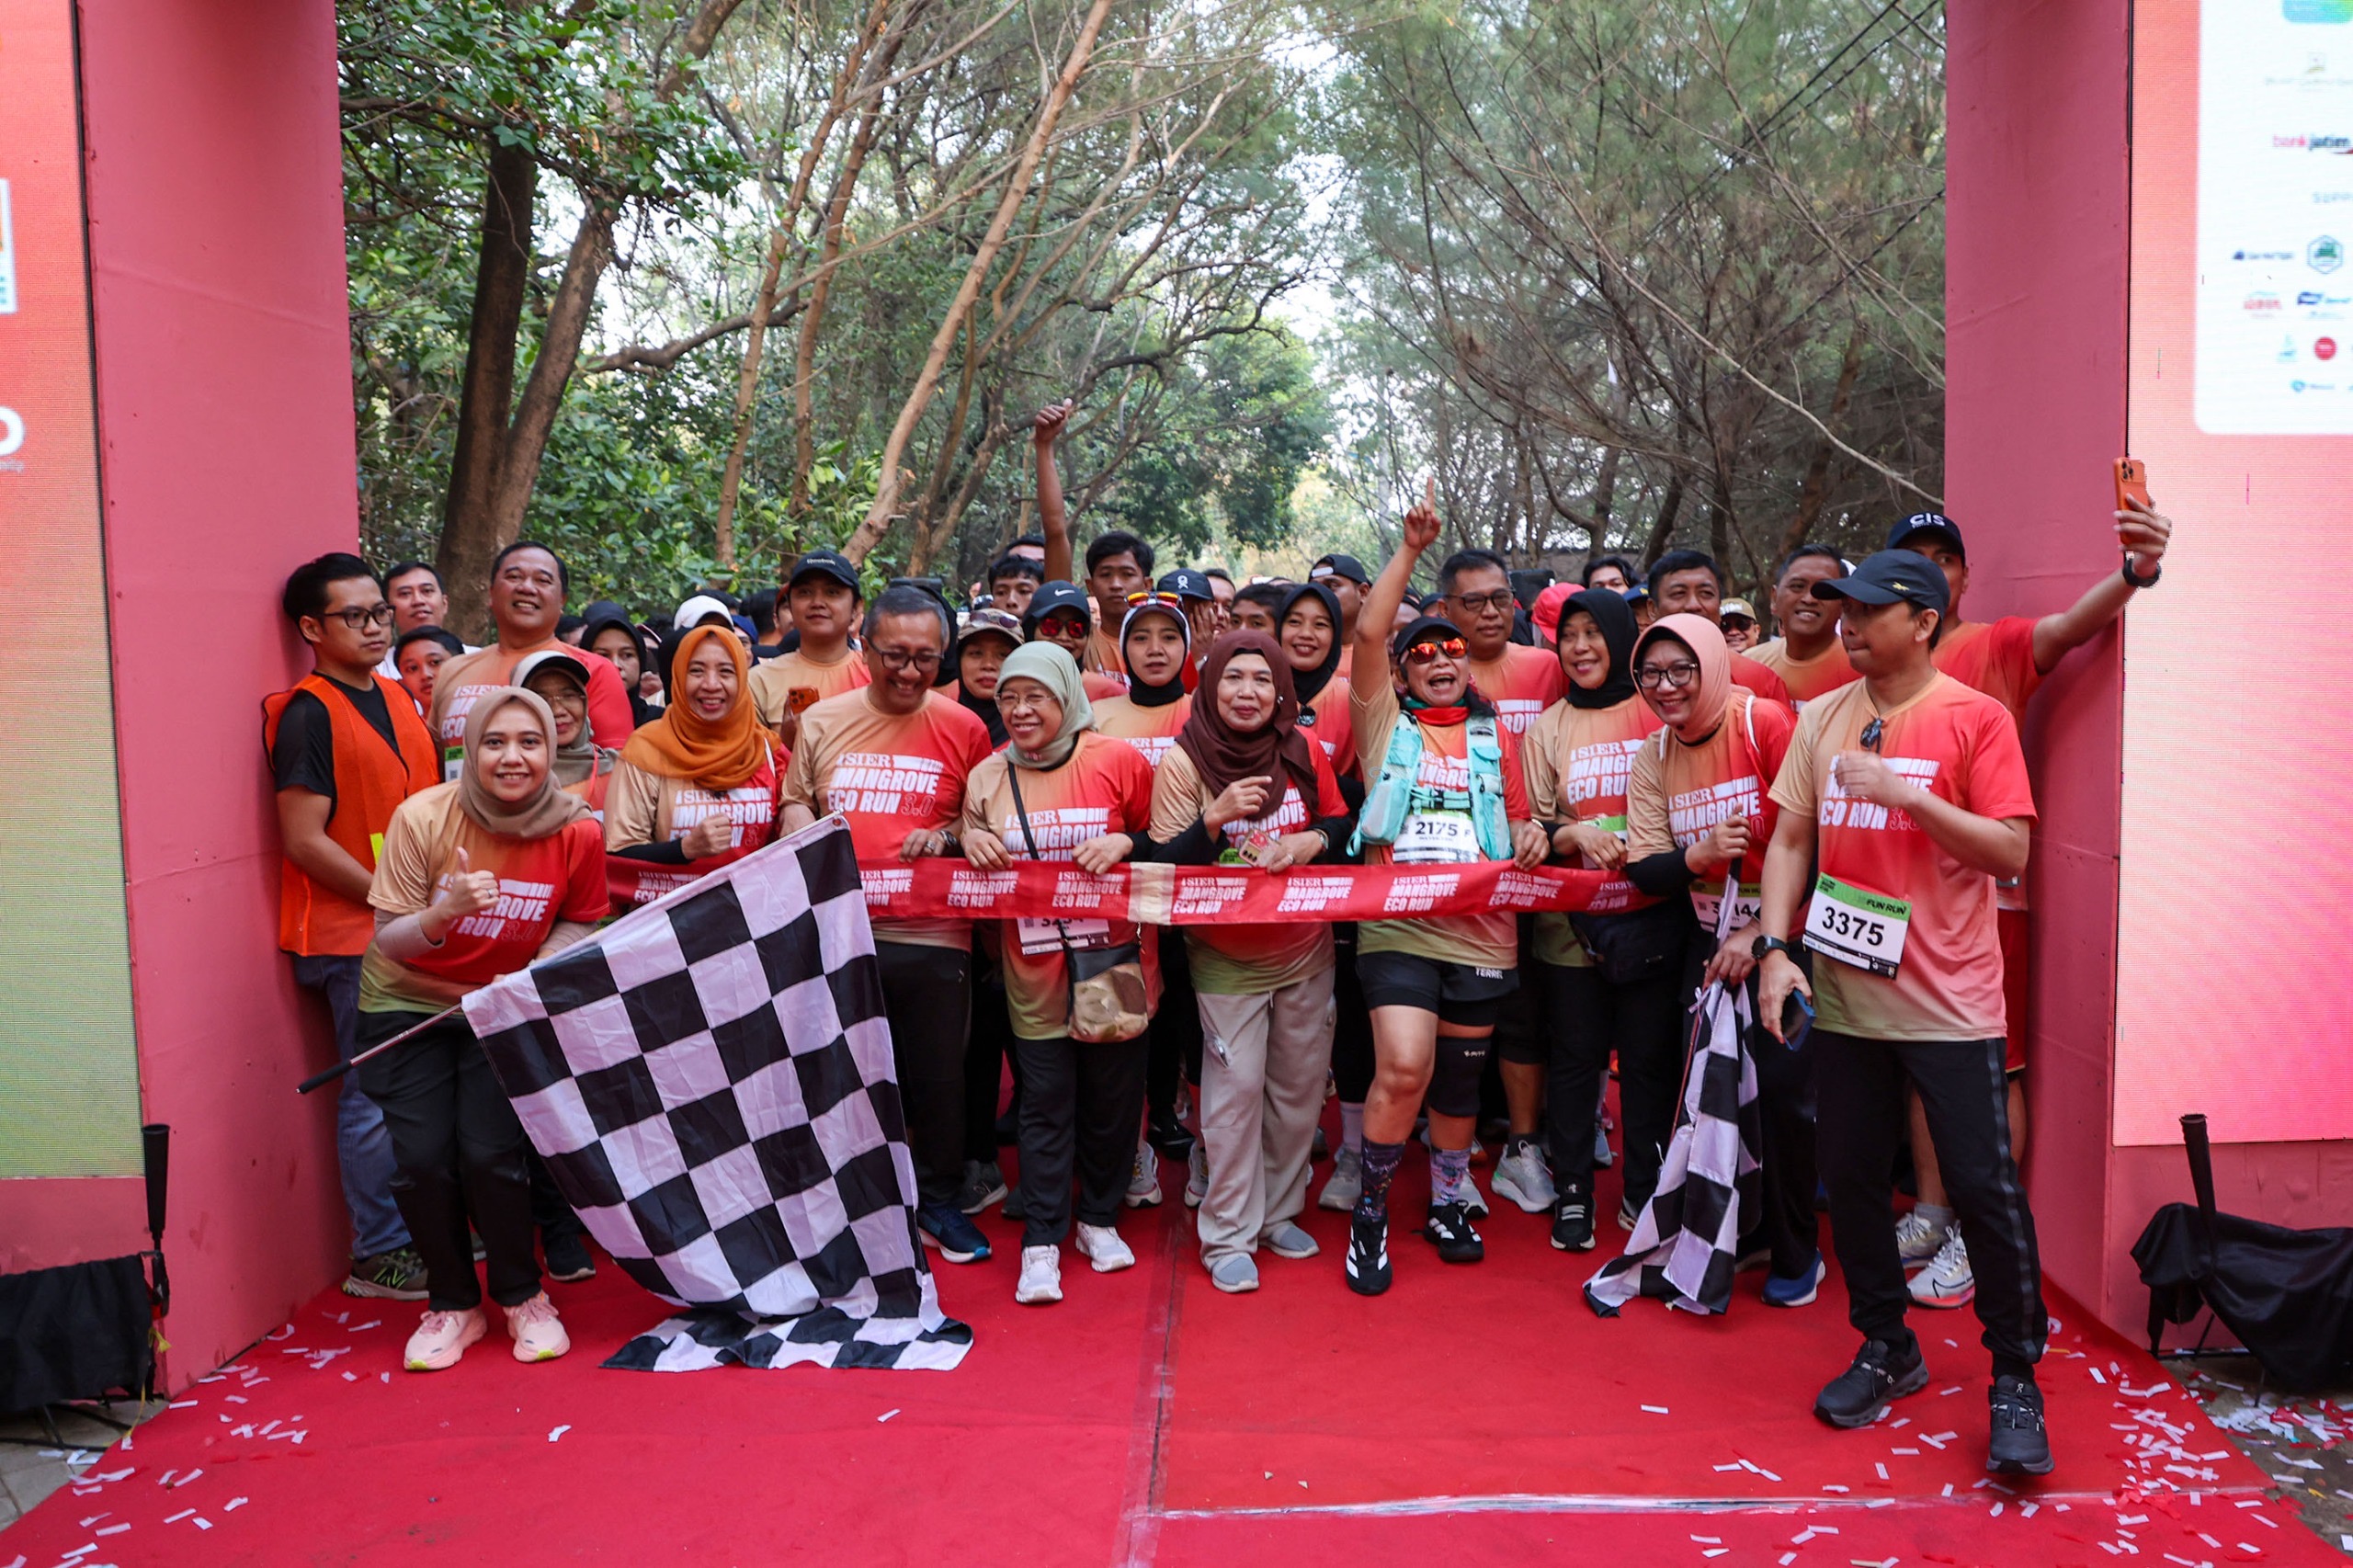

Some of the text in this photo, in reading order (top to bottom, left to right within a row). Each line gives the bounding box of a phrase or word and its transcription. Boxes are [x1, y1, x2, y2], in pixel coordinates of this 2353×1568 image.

[1909, 512, 1945, 527] CIS
[1578, 741, 1623, 760] SIER
[845, 753, 892, 767] SIER
[1568, 752, 1637, 781] MANGR
[829, 767, 939, 795] MANGROVE
[1566, 774, 1629, 805] ECO RU
[1675, 787, 1712, 808] SIER
[827, 789, 936, 817] ECO RUN 3.0
[1847, 801, 1889, 831] RUN
[1415, 821, 1459, 837] 2175
[862, 879, 913, 894] ANGROVE
[949, 881, 1017, 894] MANGROVE
[1055, 881, 1123, 894] MANGROVE
[1179, 887, 1246, 901] MANGROVE
[1283, 886, 1351, 900] MANGROVE
[1388, 883, 1458, 898] MANGROVE
[1495, 880, 1560, 900] MANGROVE
[479, 893, 550, 922] ROVE
[947, 893, 967, 907] ECO
[969, 894, 995, 907] RUN
[1051, 894, 1101, 908] ECO RUN
[1172, 900, 1195, 914] ECO
[1196, 900, 1222, 914] RUN
[1277, 900, 1301, 912] ECO
[1301, 899, 1327, 911] RUN
[1383, 897, 1435, 912] ECO RUN
[1866, 898, 1907, 915] FUN RUN
[1711, 901, 1755, 918] 314
[457, 915, 506, 939] RUN
[1822, 906, 1885, 947] 3375
